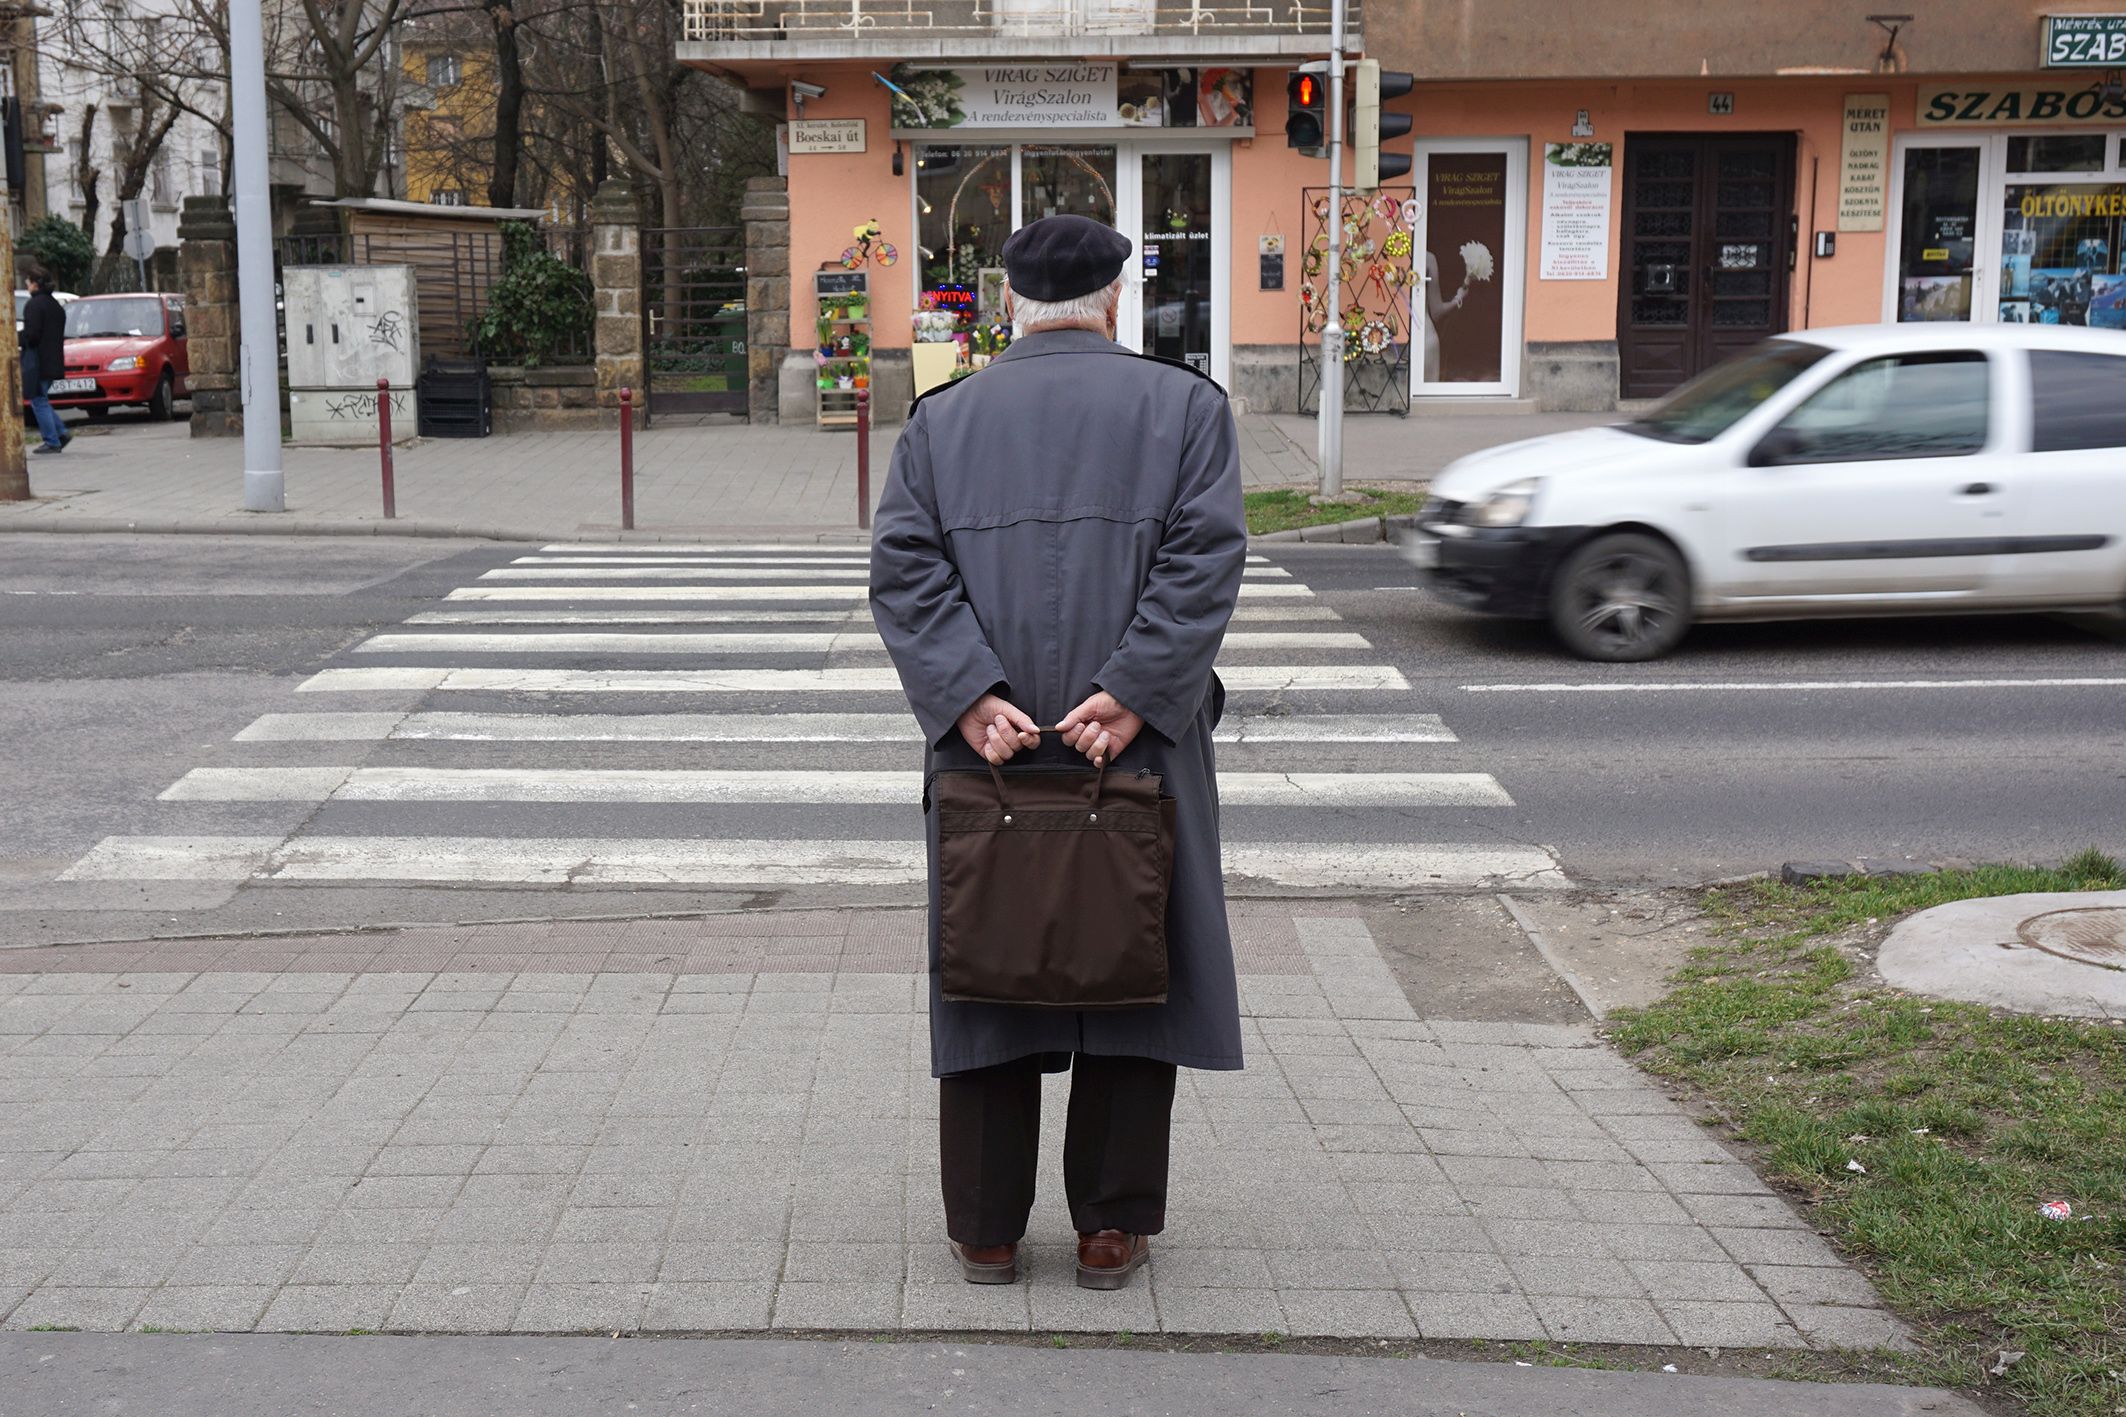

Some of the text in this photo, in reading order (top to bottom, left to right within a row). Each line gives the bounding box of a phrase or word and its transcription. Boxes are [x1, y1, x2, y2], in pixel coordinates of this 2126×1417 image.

[2052, 33, 2126, 61] SZAB
[1044, 67, 1113, 82] SZIGET
[1713, 95, 1730, 112] 44
[968, 110, 1107, 123] A rendezvényspecialista
[796, 130, 859, 143] Bocskai út
[1144, 231, 1209, 240] klimatizált üzlet
[932, 291, 973, 303] NYITVA
